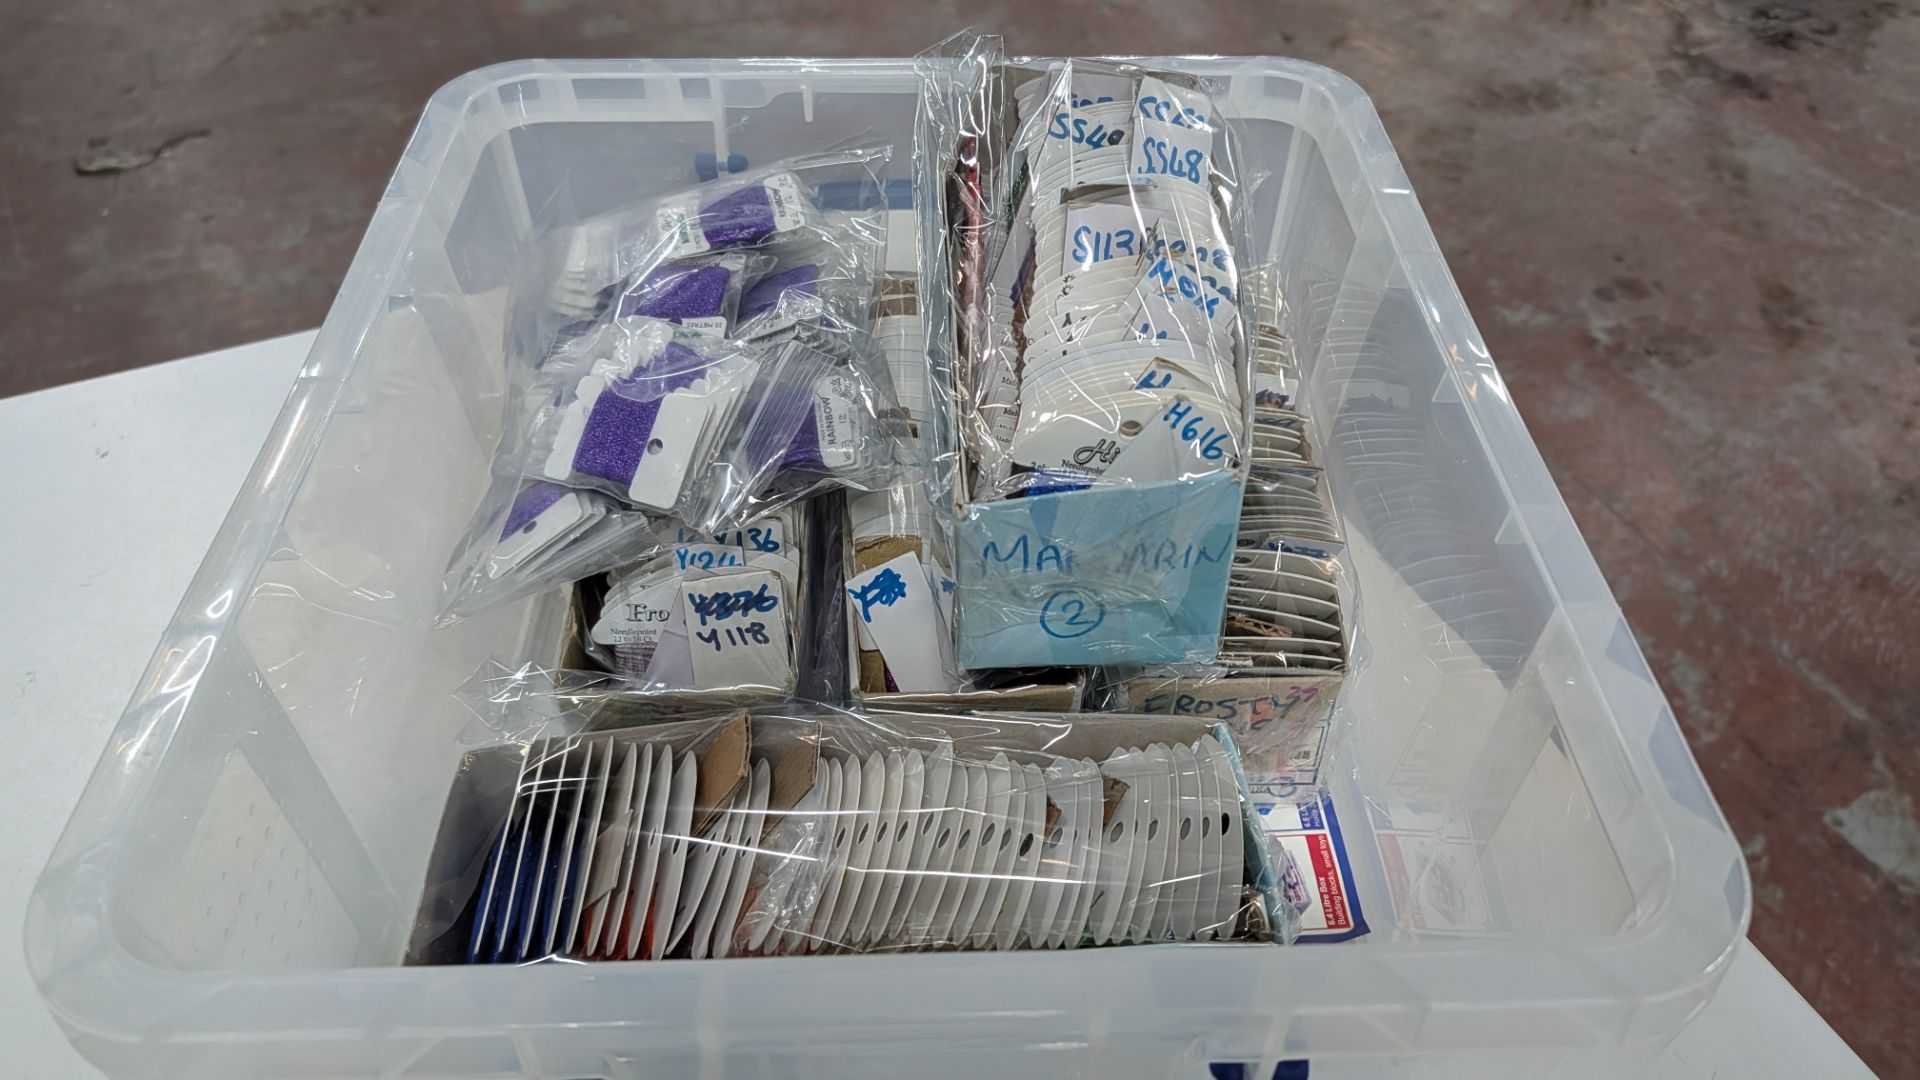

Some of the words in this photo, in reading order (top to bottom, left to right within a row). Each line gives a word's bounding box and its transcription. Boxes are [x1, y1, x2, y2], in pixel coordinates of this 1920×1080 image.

[821, 397, 837, 446] RAINBOW
[838, 413, 847, 424] 12
[1162, 402, 1227, 460] H616
[625, 603, 670, 622] Fro
[610, 628, 657, 636] Needlepoint
[696, 621, 770, 651] Y118
[1317, 835, 1328, 850] toys
[1320, 850, 1332, 869] small
[1318, 876, 1328, 893] Box
[1323, 894, 1334, 913] Litre
[1333, 895, 1346, 926] Building
[1327, 913, 1336, 926] 6.4
